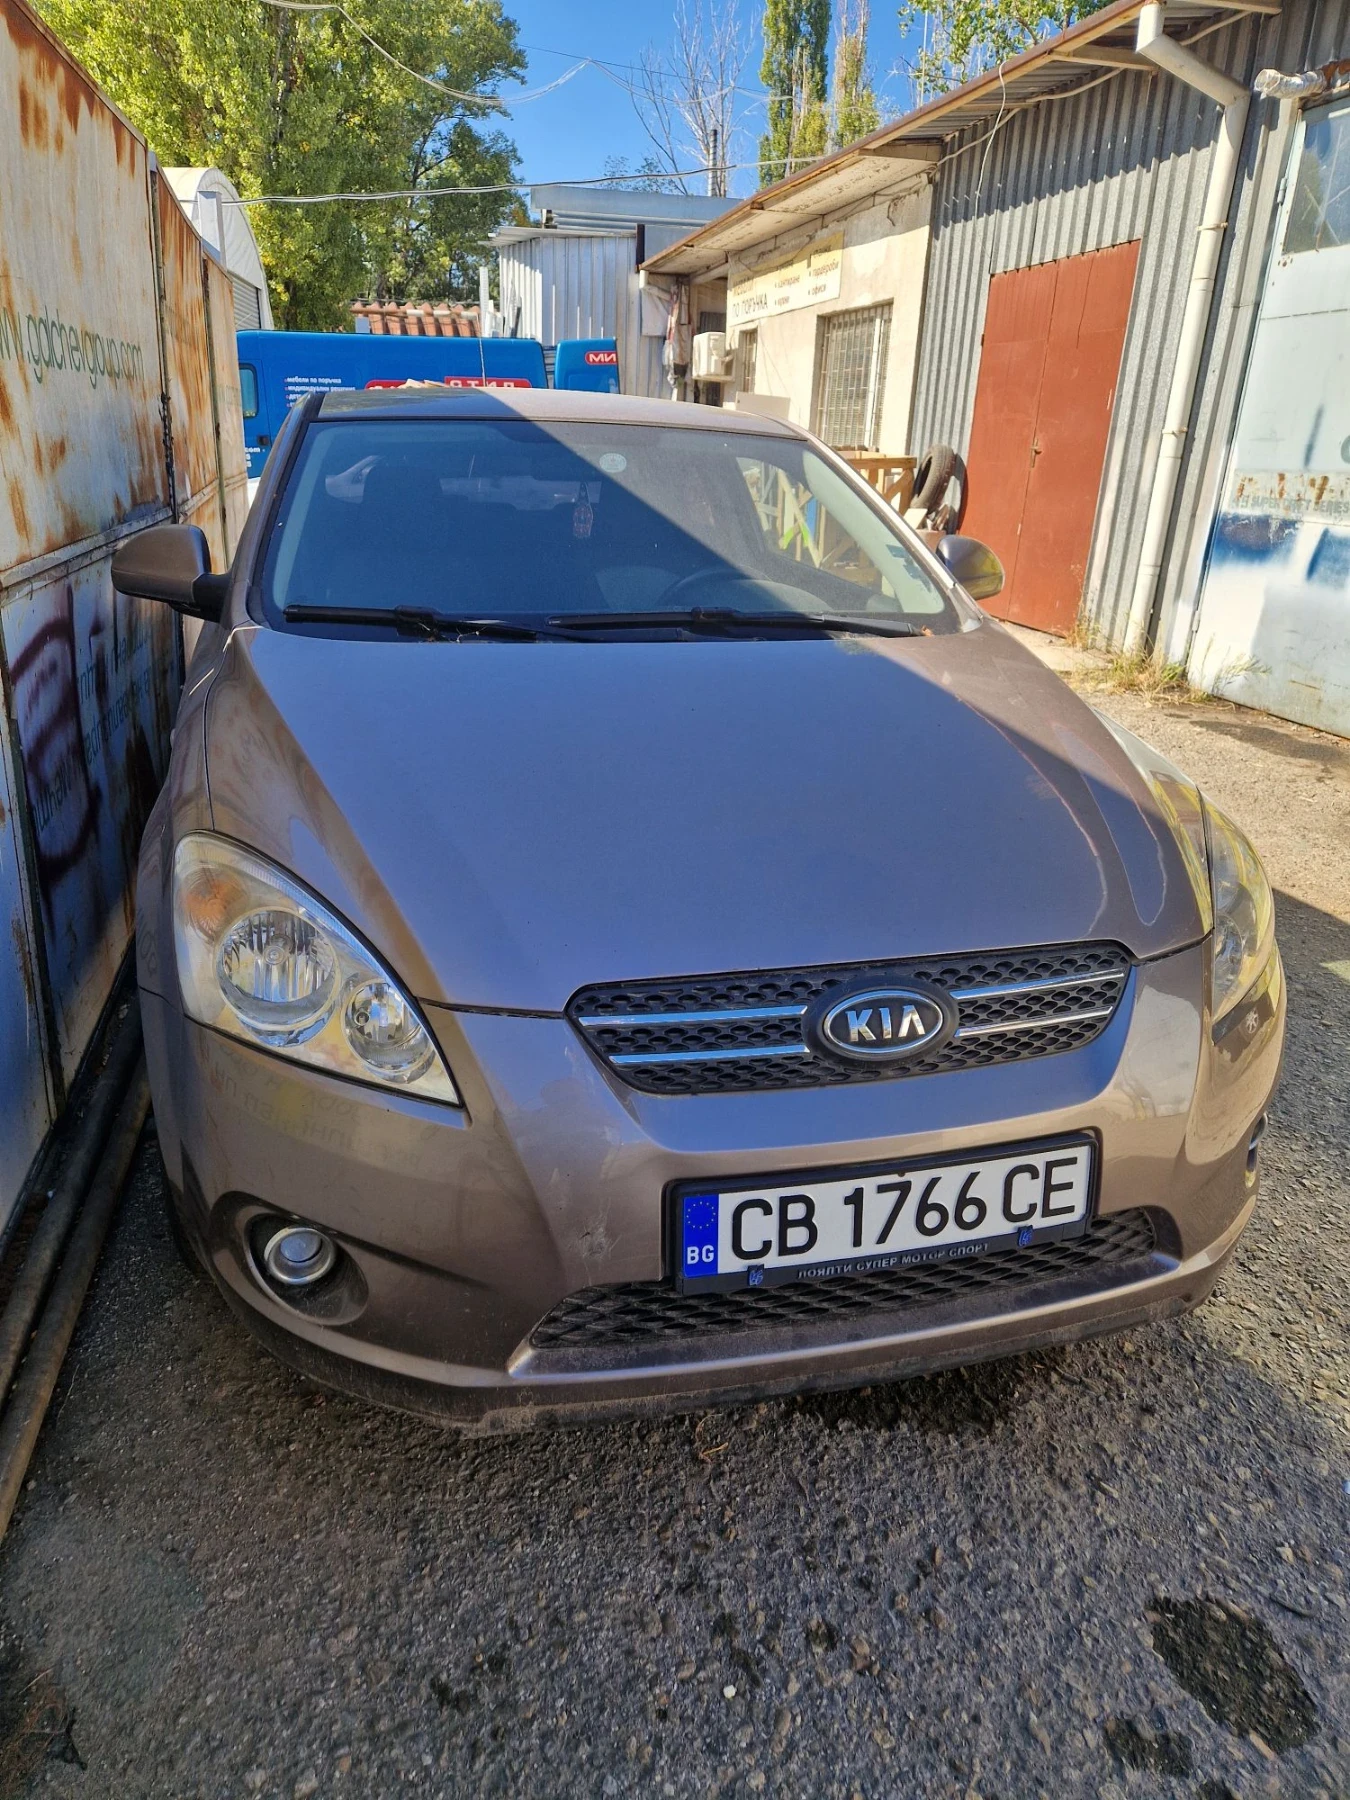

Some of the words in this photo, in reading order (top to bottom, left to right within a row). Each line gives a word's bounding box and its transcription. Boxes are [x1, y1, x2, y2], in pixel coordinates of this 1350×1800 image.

[845, 1005, 926, 1041] KIA
[732, 1194, 818, 1260] CB
[844, 1170, 987, 1248] 1766
[1002, 1157, 1078, 1223] CE
[687, 1245, 715, 1264] BG
